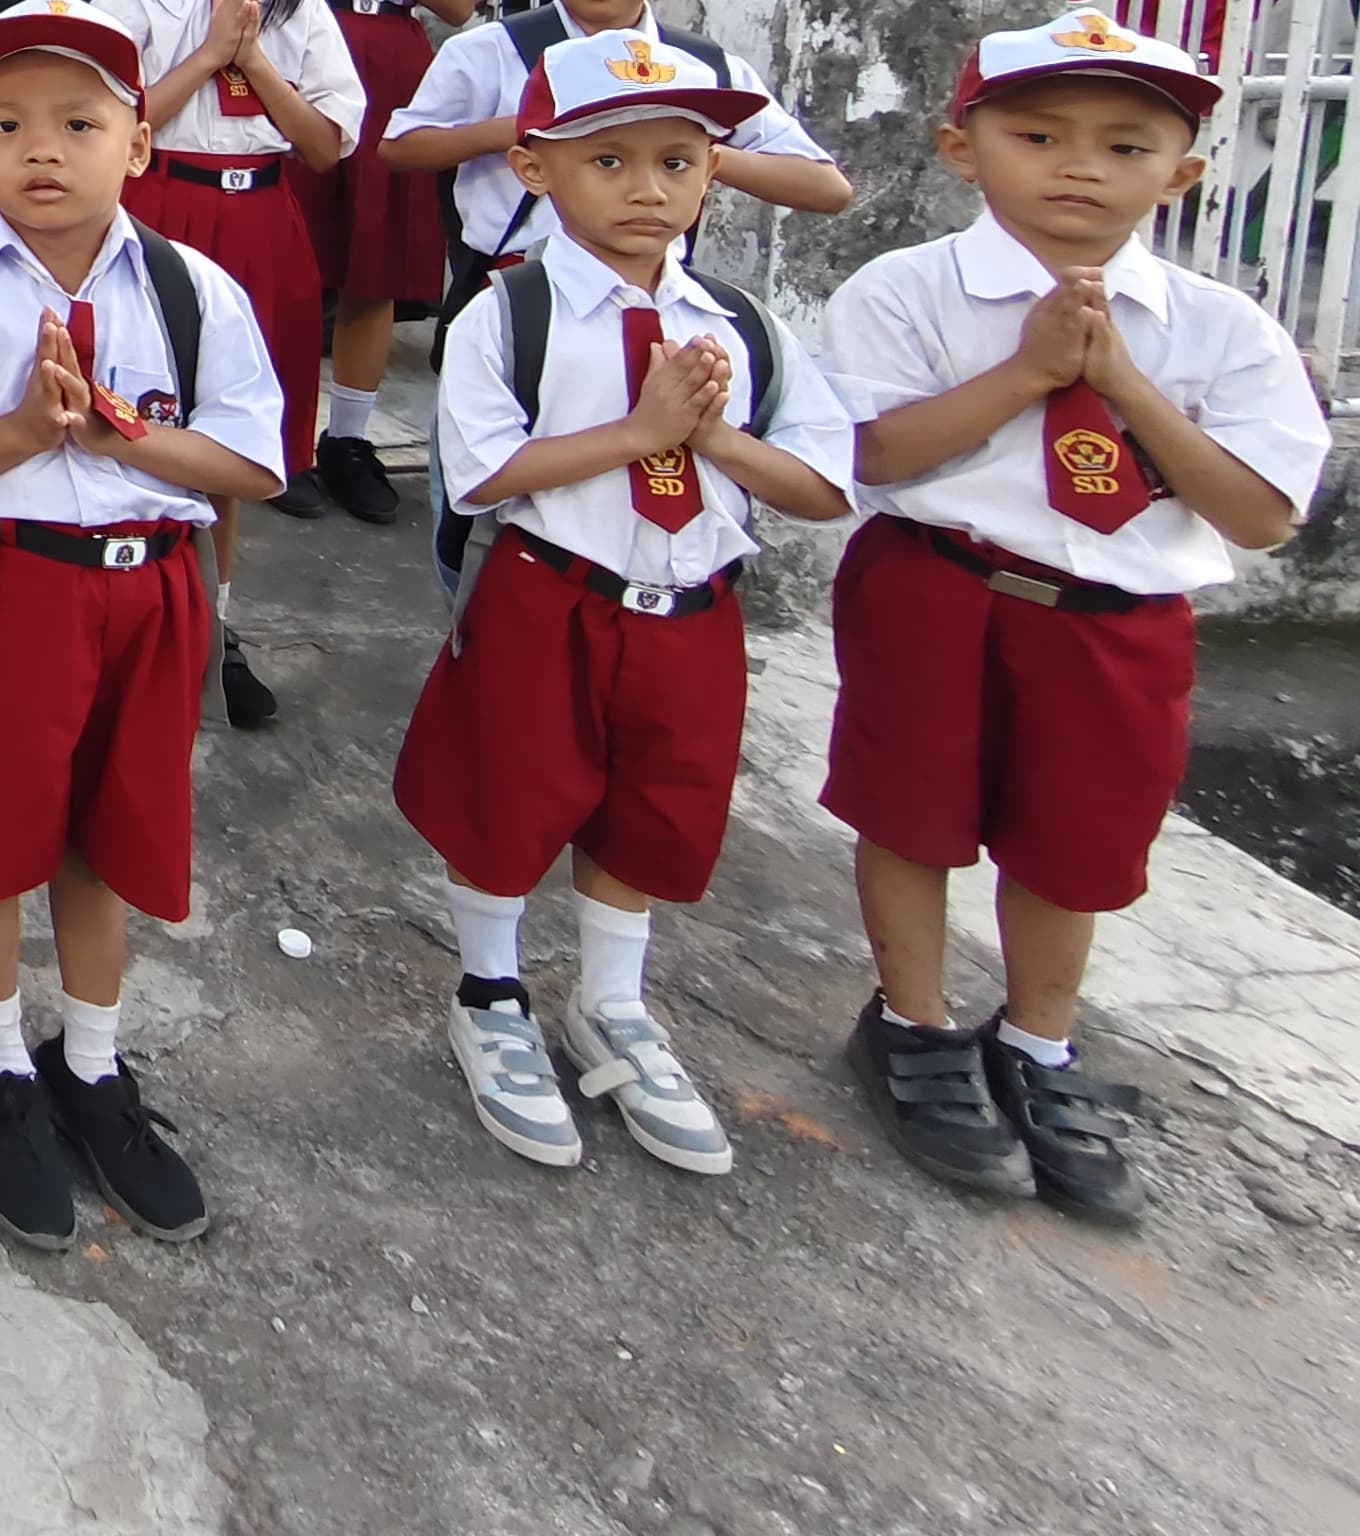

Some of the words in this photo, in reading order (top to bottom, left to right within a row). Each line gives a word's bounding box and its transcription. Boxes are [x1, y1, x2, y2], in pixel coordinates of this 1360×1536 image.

[230, 84, 248, 96] SD
[648, 478, 685, 496] SD
[1072, 475, 1119, 494] SD
